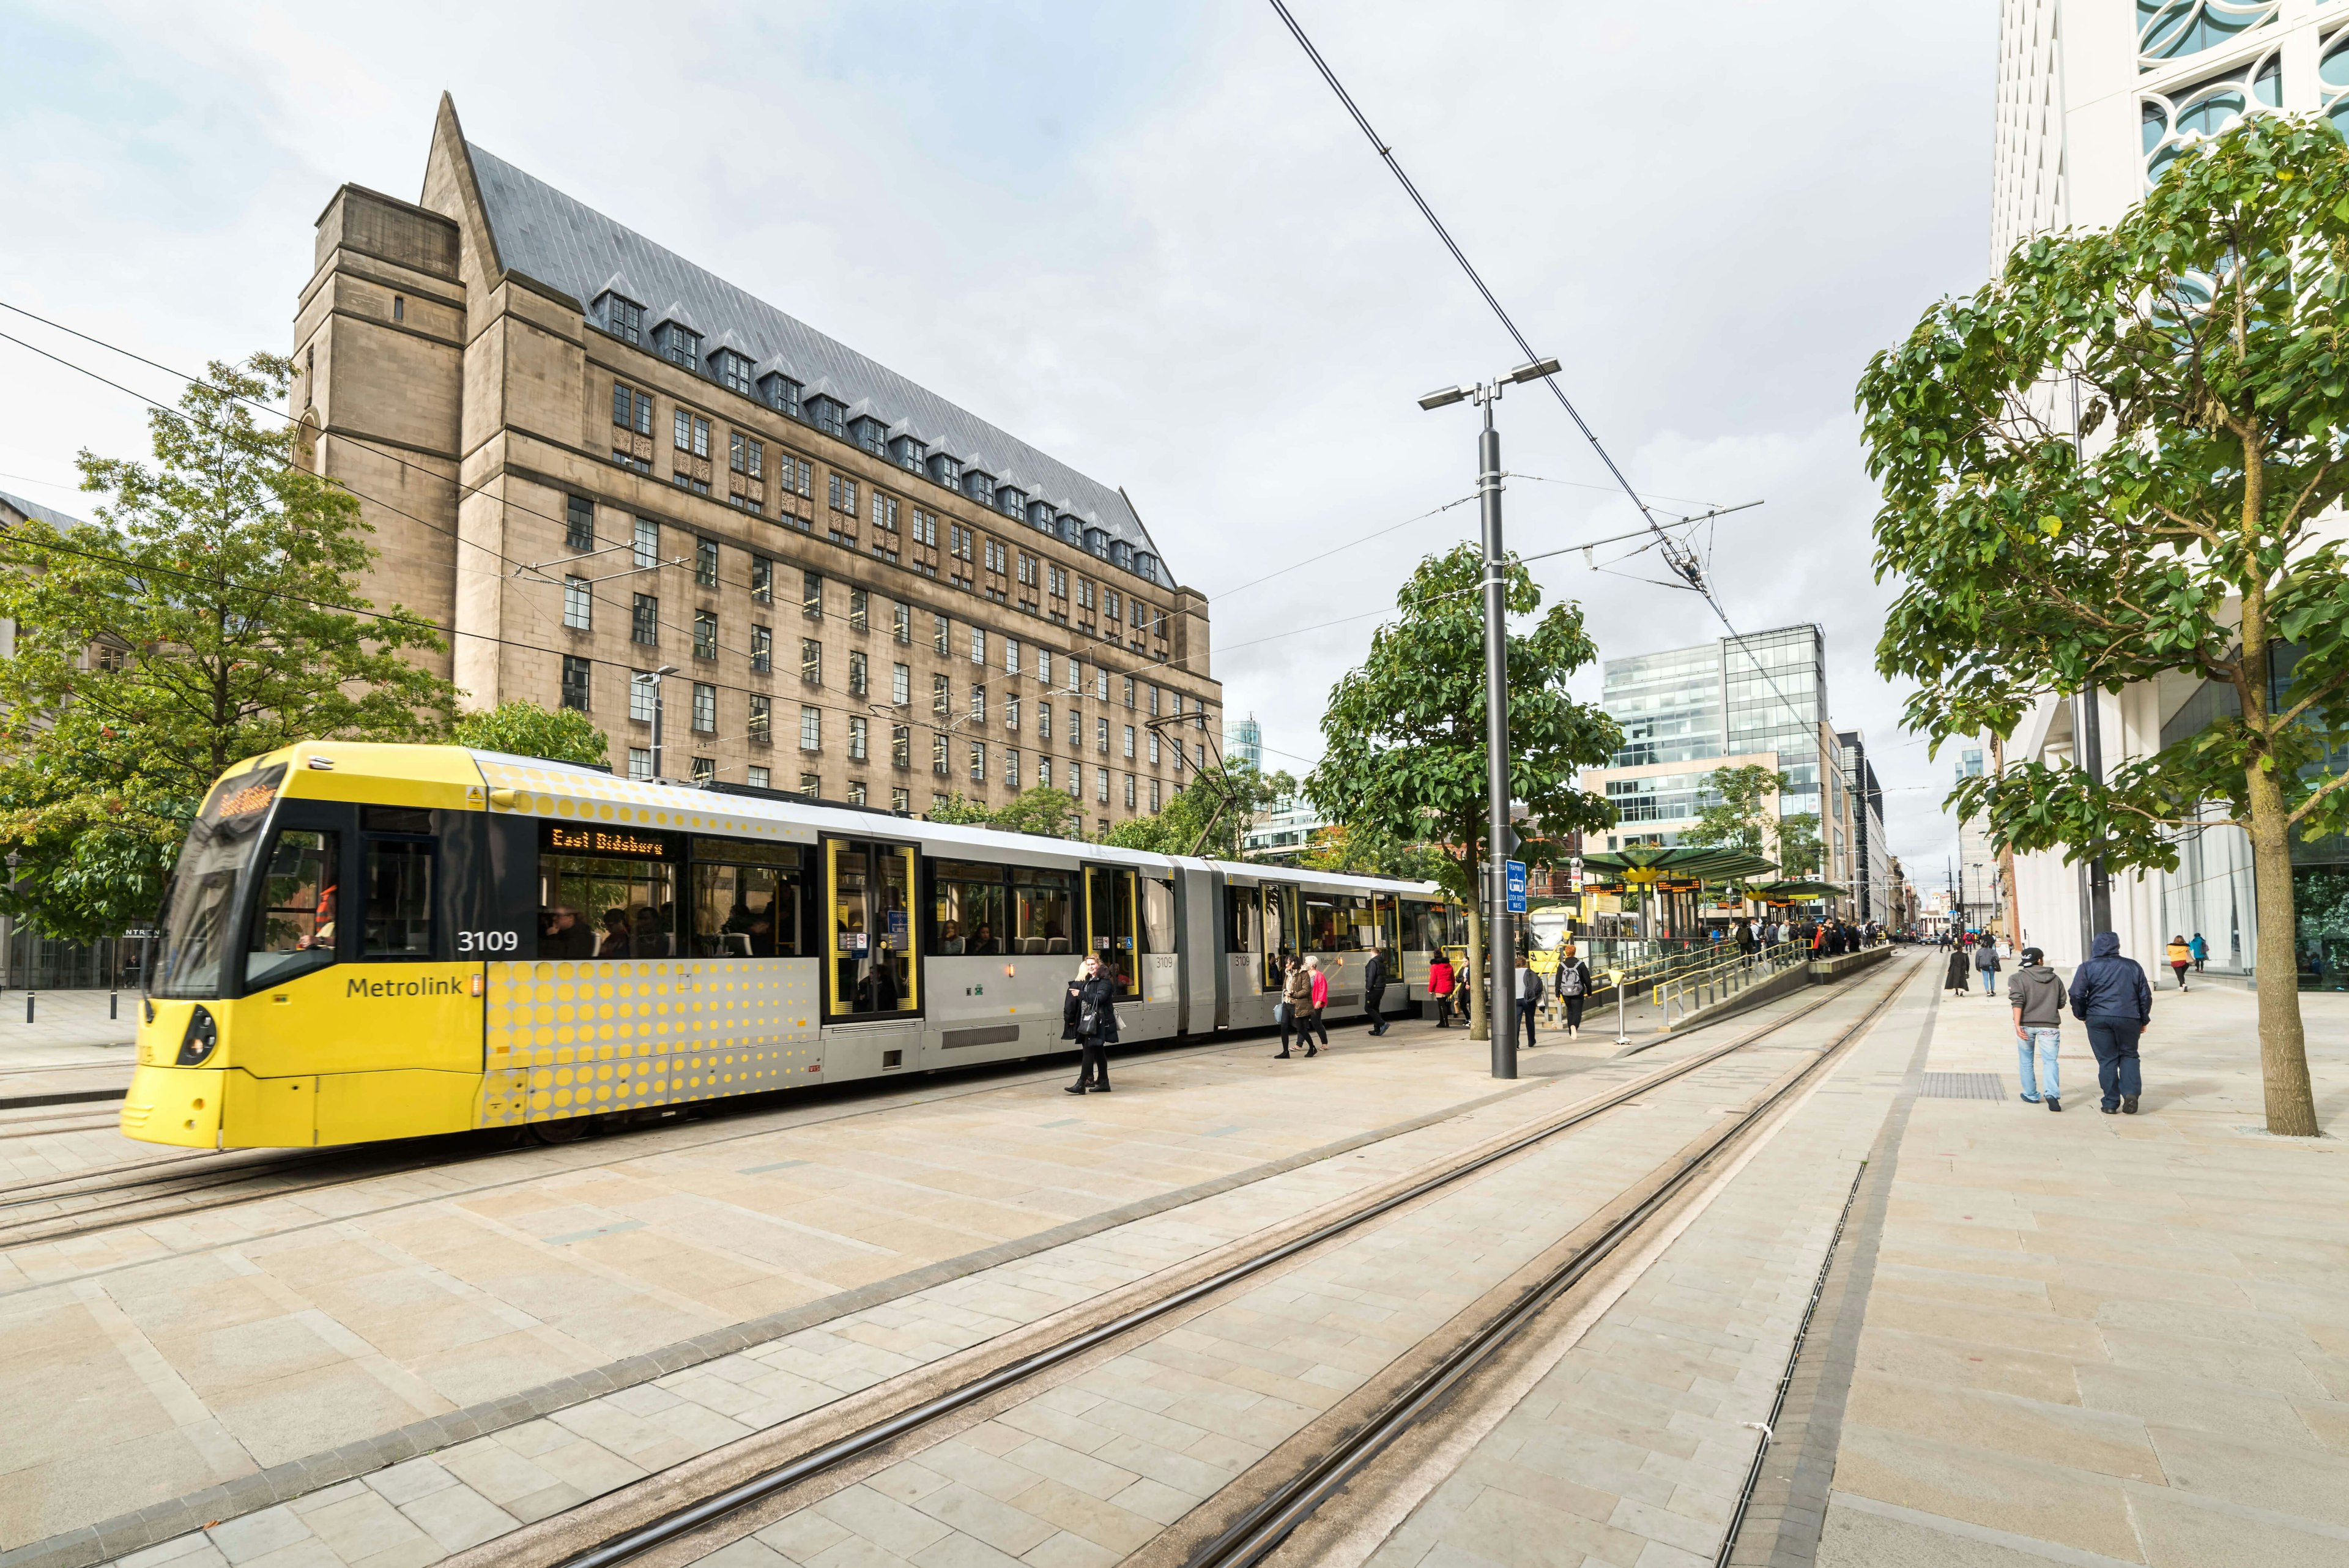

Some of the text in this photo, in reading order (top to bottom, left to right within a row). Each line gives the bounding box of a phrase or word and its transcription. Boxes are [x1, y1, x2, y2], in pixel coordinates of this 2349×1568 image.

[553, 829, 662, 855] East Didsbury
[458, 931, 518, 951] 3109
[1156, 957, 1173, 968] 3109
[1235, 956, 1250, 966] 3109
[346, 976, 463, 998] Metrolink
